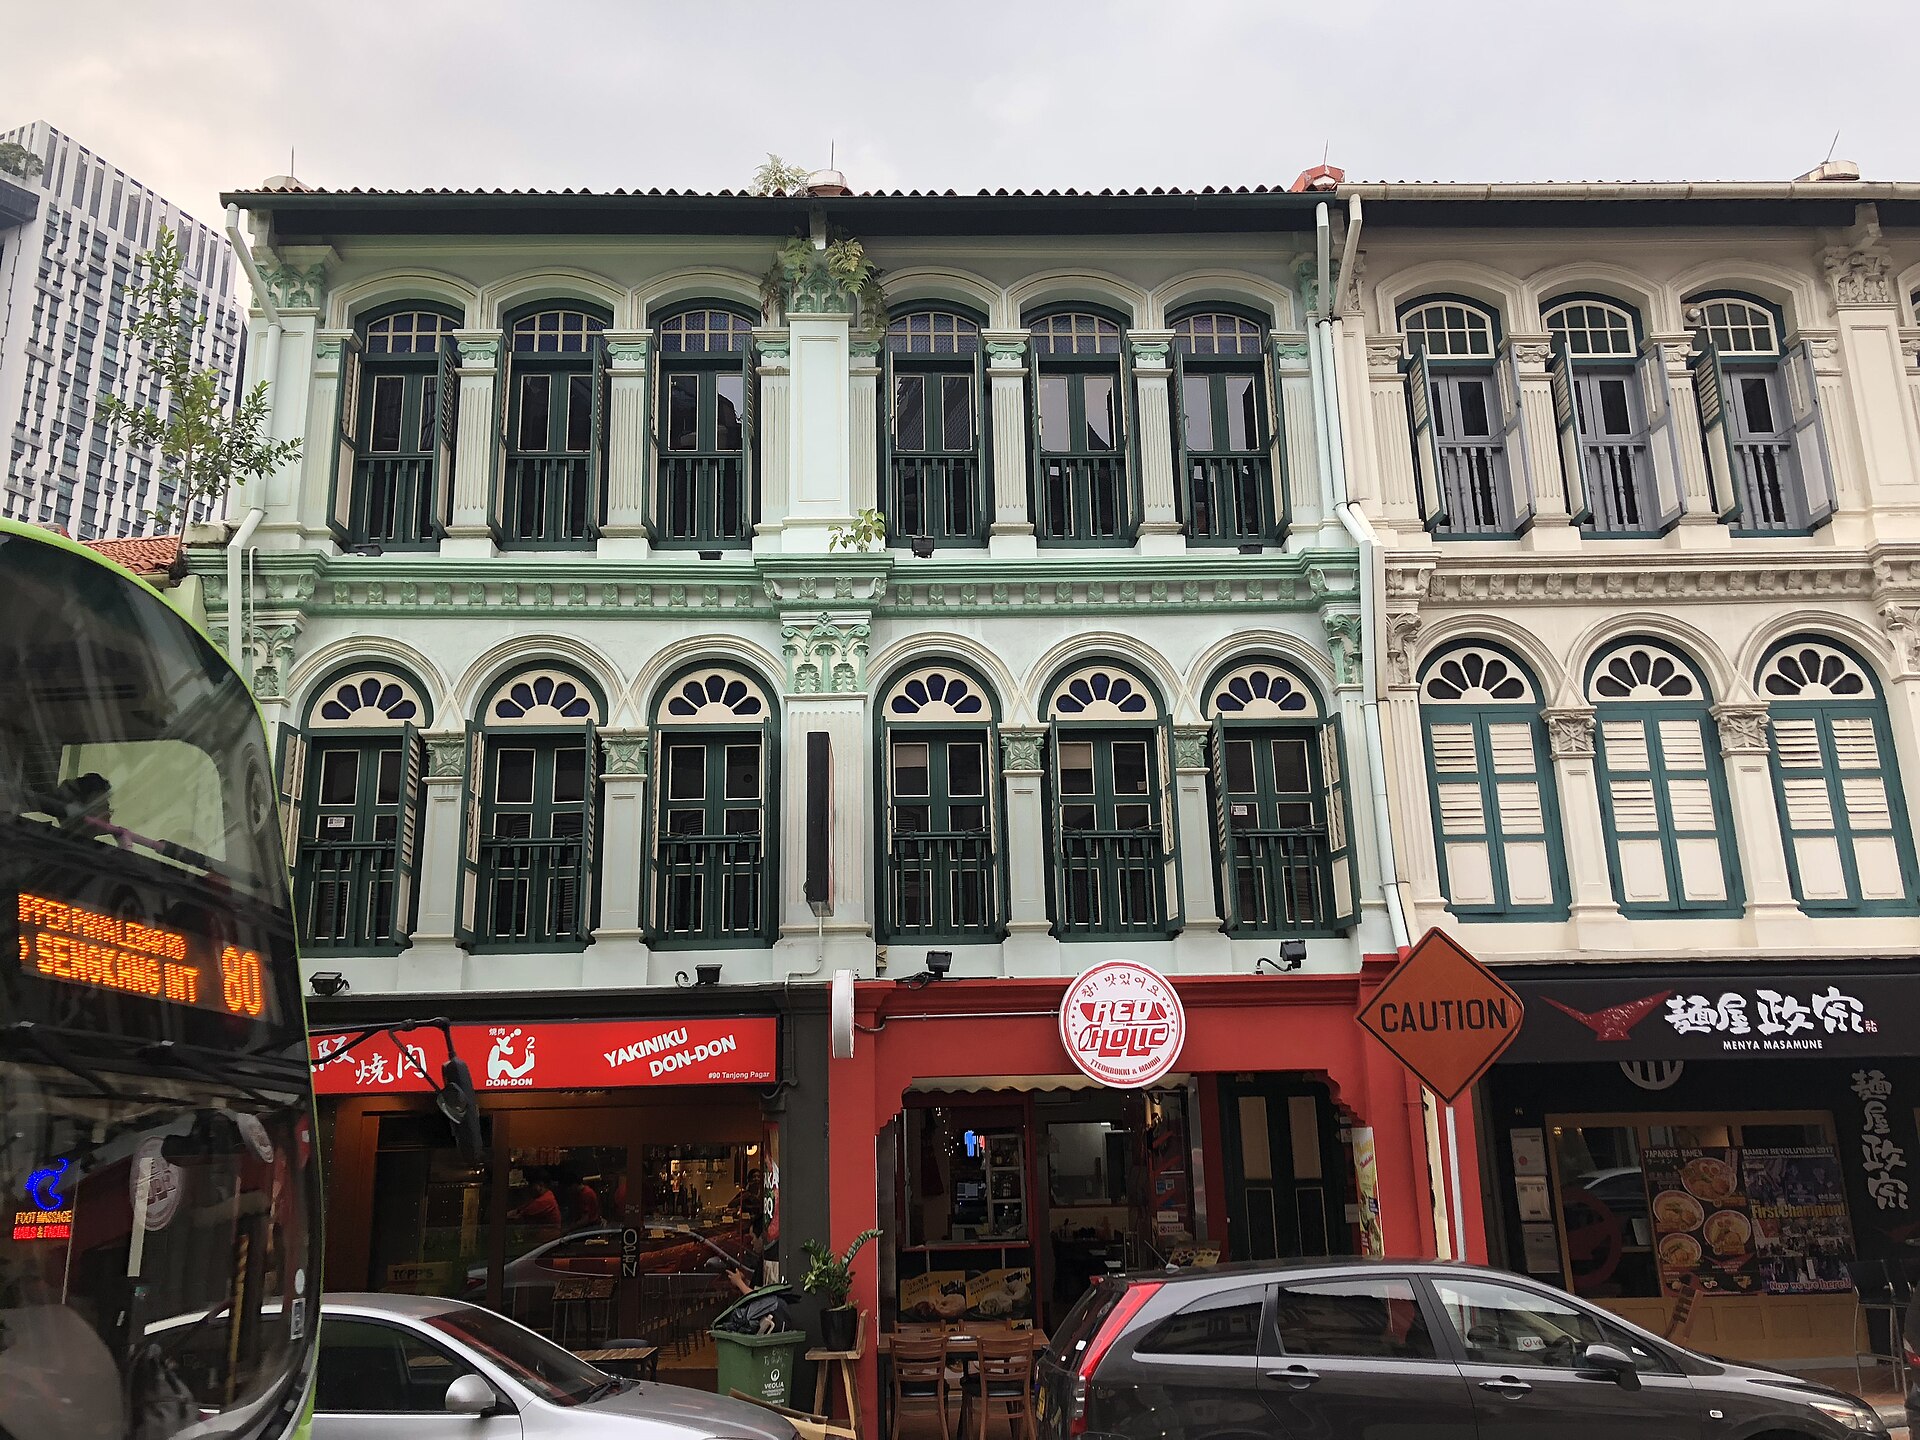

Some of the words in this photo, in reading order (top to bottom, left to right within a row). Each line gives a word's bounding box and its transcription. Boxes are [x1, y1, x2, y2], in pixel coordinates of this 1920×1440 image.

[36, 932, 161, 994] SENGKANG
[163, 962, 200, 1003] INT
[221, 945, 263, 1016] 80
[1092, 1000, 1154, 1024] RED
[1380, 998, 1507, 1033] CAUTION
[603, 1026, 688, 1068] YAKINIKU
[1080, 1023, 1169, 1057] HOLIC
[1722, 1040, 1760, 1051] MENYA
[1763, 1040, 1824, 1050] MASAMUNE
[648, 1034, 737, 1078] DON-DON
[485, 1078, 533, 1087] DON-DON
[708, 1071, 721, 1079] #90
[722, 1071, 749, 1080] Tanjong
[750, 1071, 770, 1080] Pagar
[1644, 1149, 1679, 1158] JAPANESE
[1681, 1149, 1704, 1157] RAMEN
[1742, 1148, 1769, 1156] RAMEN
[1769, 1147, 1816, 1155] REVOLUTION
[14, 1211, 36, 1224] FOOT
[36, 1210, 72, 1223] MASSAGE
[1751, 1203, 1780, 1219] First
[1781, 1202, 1846, 1218] Champion!
[1769, 1281, 1789, 1290] Now
